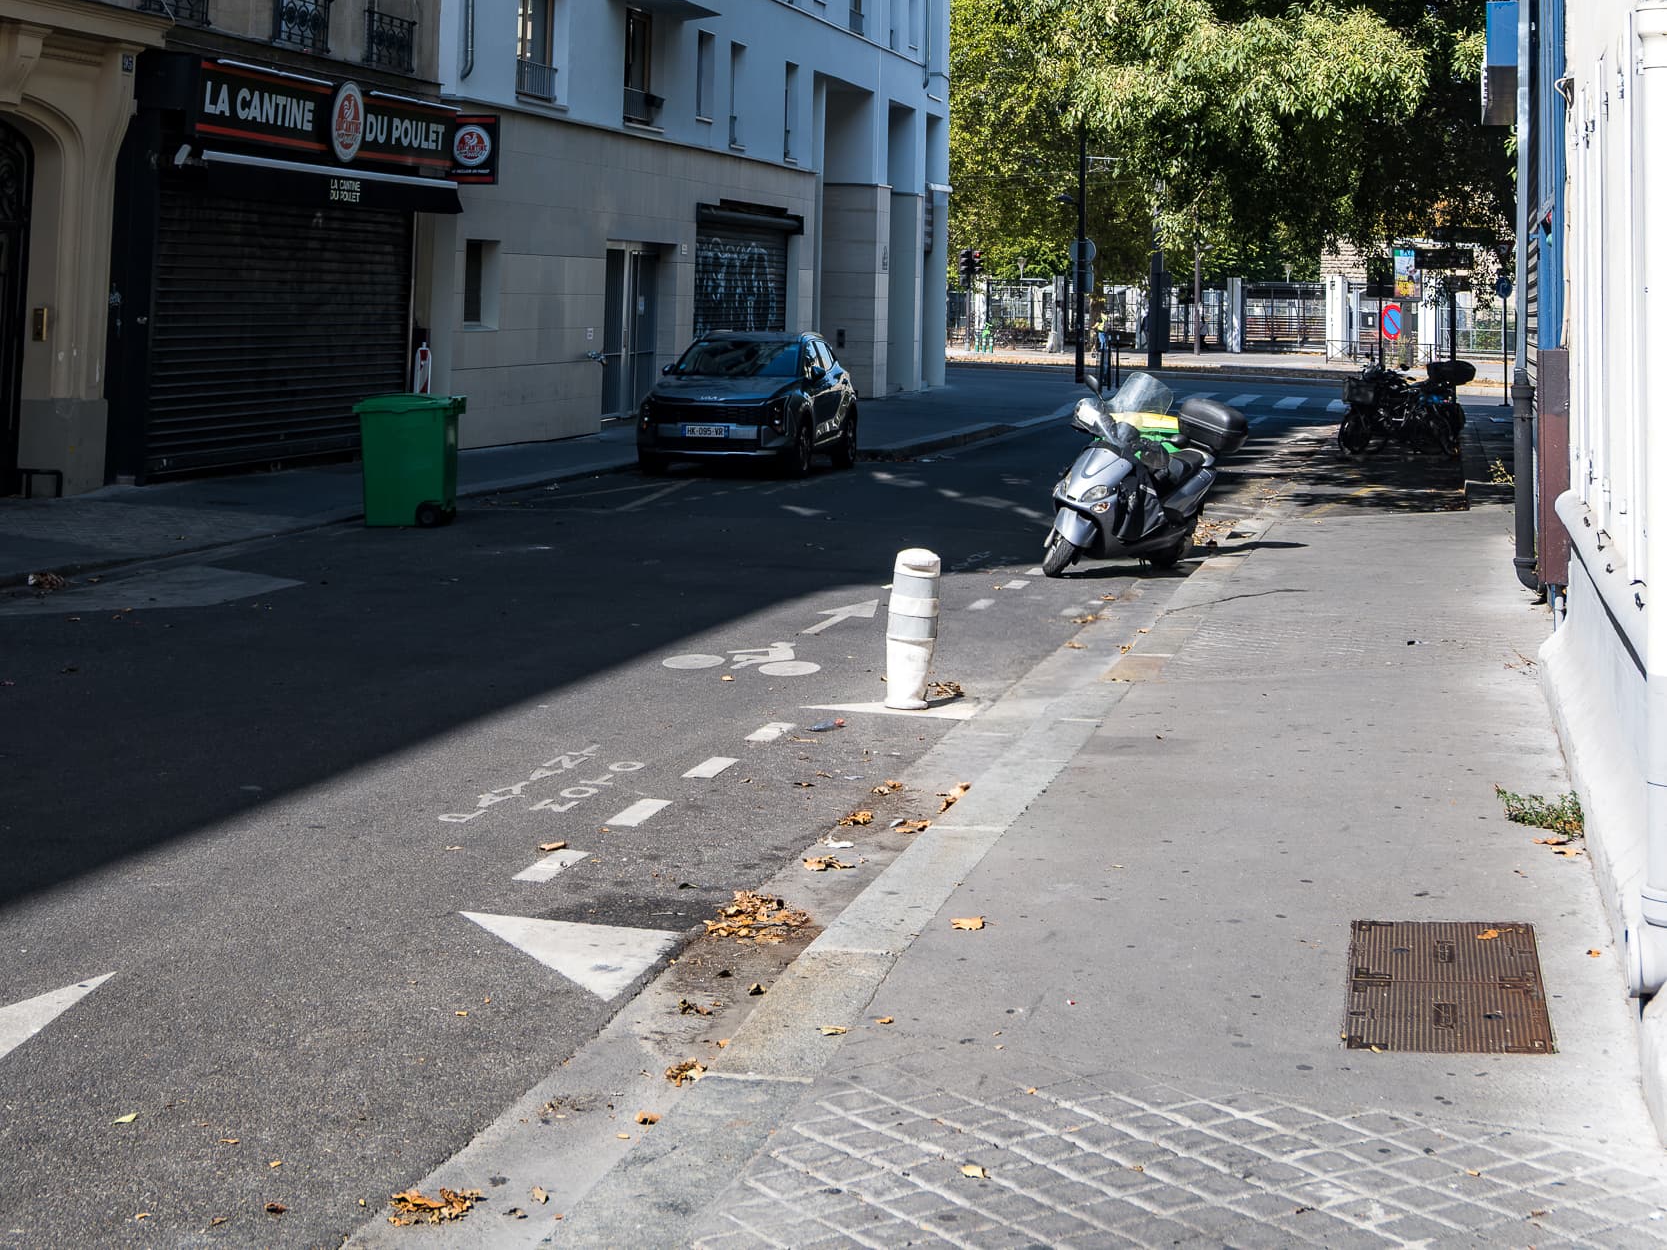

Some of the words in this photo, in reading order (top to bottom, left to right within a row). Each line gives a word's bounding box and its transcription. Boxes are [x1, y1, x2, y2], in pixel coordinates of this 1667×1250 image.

[204, 81, 230, 116] LA
[236, 88, 315, 131] CANTINE
[365, 114, 388, 144] DU
[391, 118, 445, 151] POULET
[330, 179, 338, 189] LA
[330, 190, 339, 200] DU
[529, 761, 645, 812] MOTO
